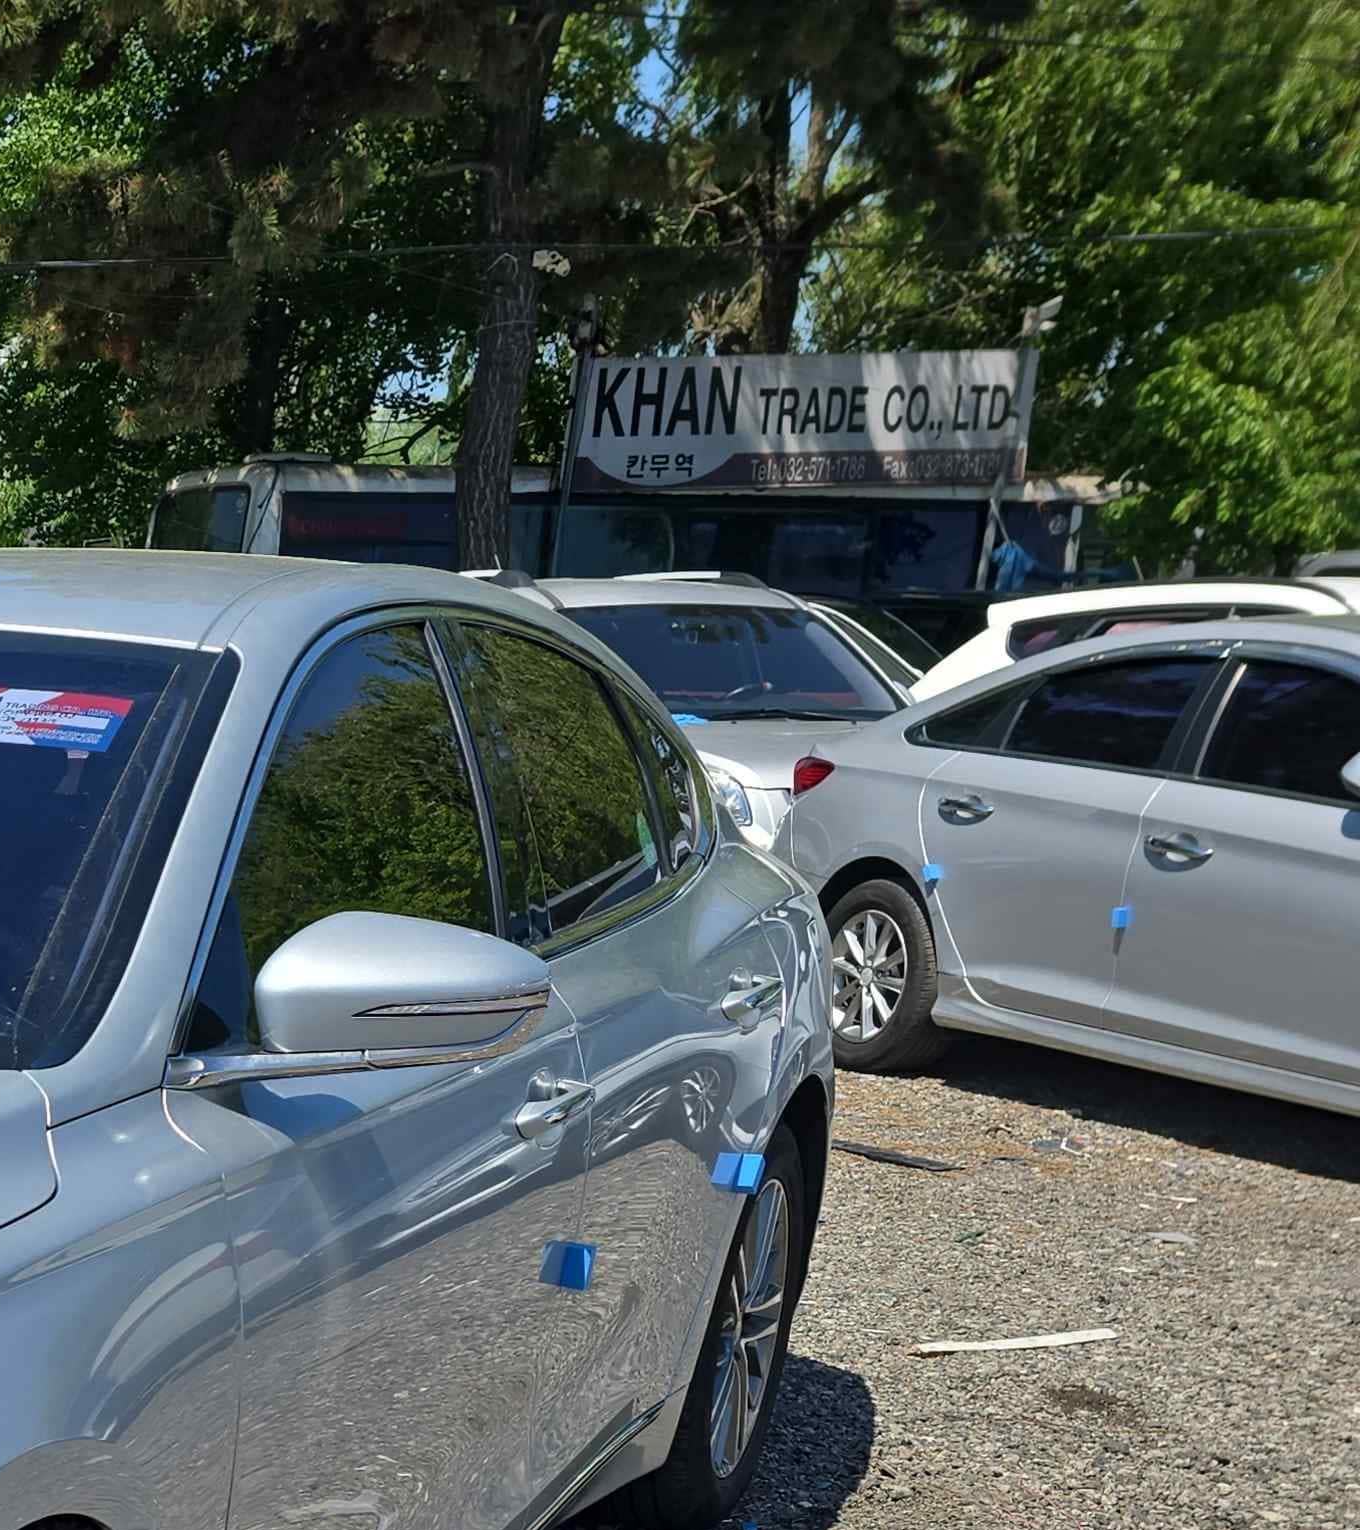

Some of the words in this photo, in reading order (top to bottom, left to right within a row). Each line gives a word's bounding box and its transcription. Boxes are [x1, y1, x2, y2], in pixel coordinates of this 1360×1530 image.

[592, 365, 743, 439] KHAN
[758, 386, 869, 435] TRADE
[882, 385, 944, 441] CO.,
[625, 452, 696, 479] 칸무역
